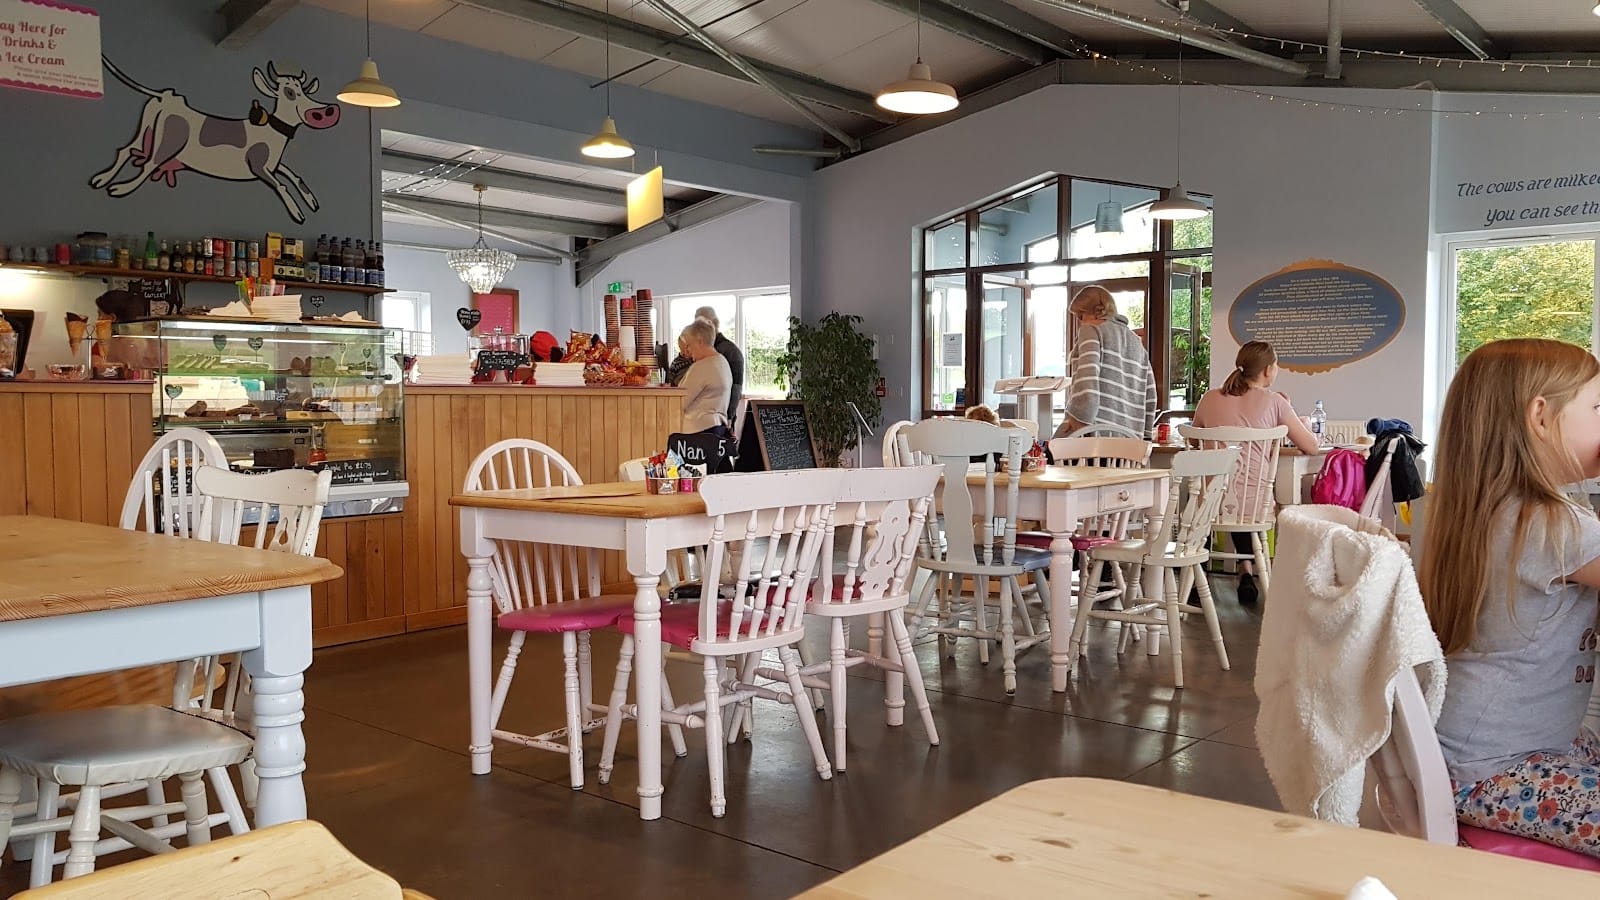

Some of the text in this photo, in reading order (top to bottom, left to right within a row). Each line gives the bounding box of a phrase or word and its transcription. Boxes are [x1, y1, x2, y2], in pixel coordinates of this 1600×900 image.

[0, 21, 67, 37] ay Here for
[3, 35, 57, 50] Drinks &
[5, 51, 65, 66] Ice Cream
[1457, 182, 1484, 197] The
[1486, 179, 1525, 195] cows
[1526, 178, 1552, 192] are
[1483, 200, 1600, 227] you can see th
[677, 439, 727, 461] Nan 5
